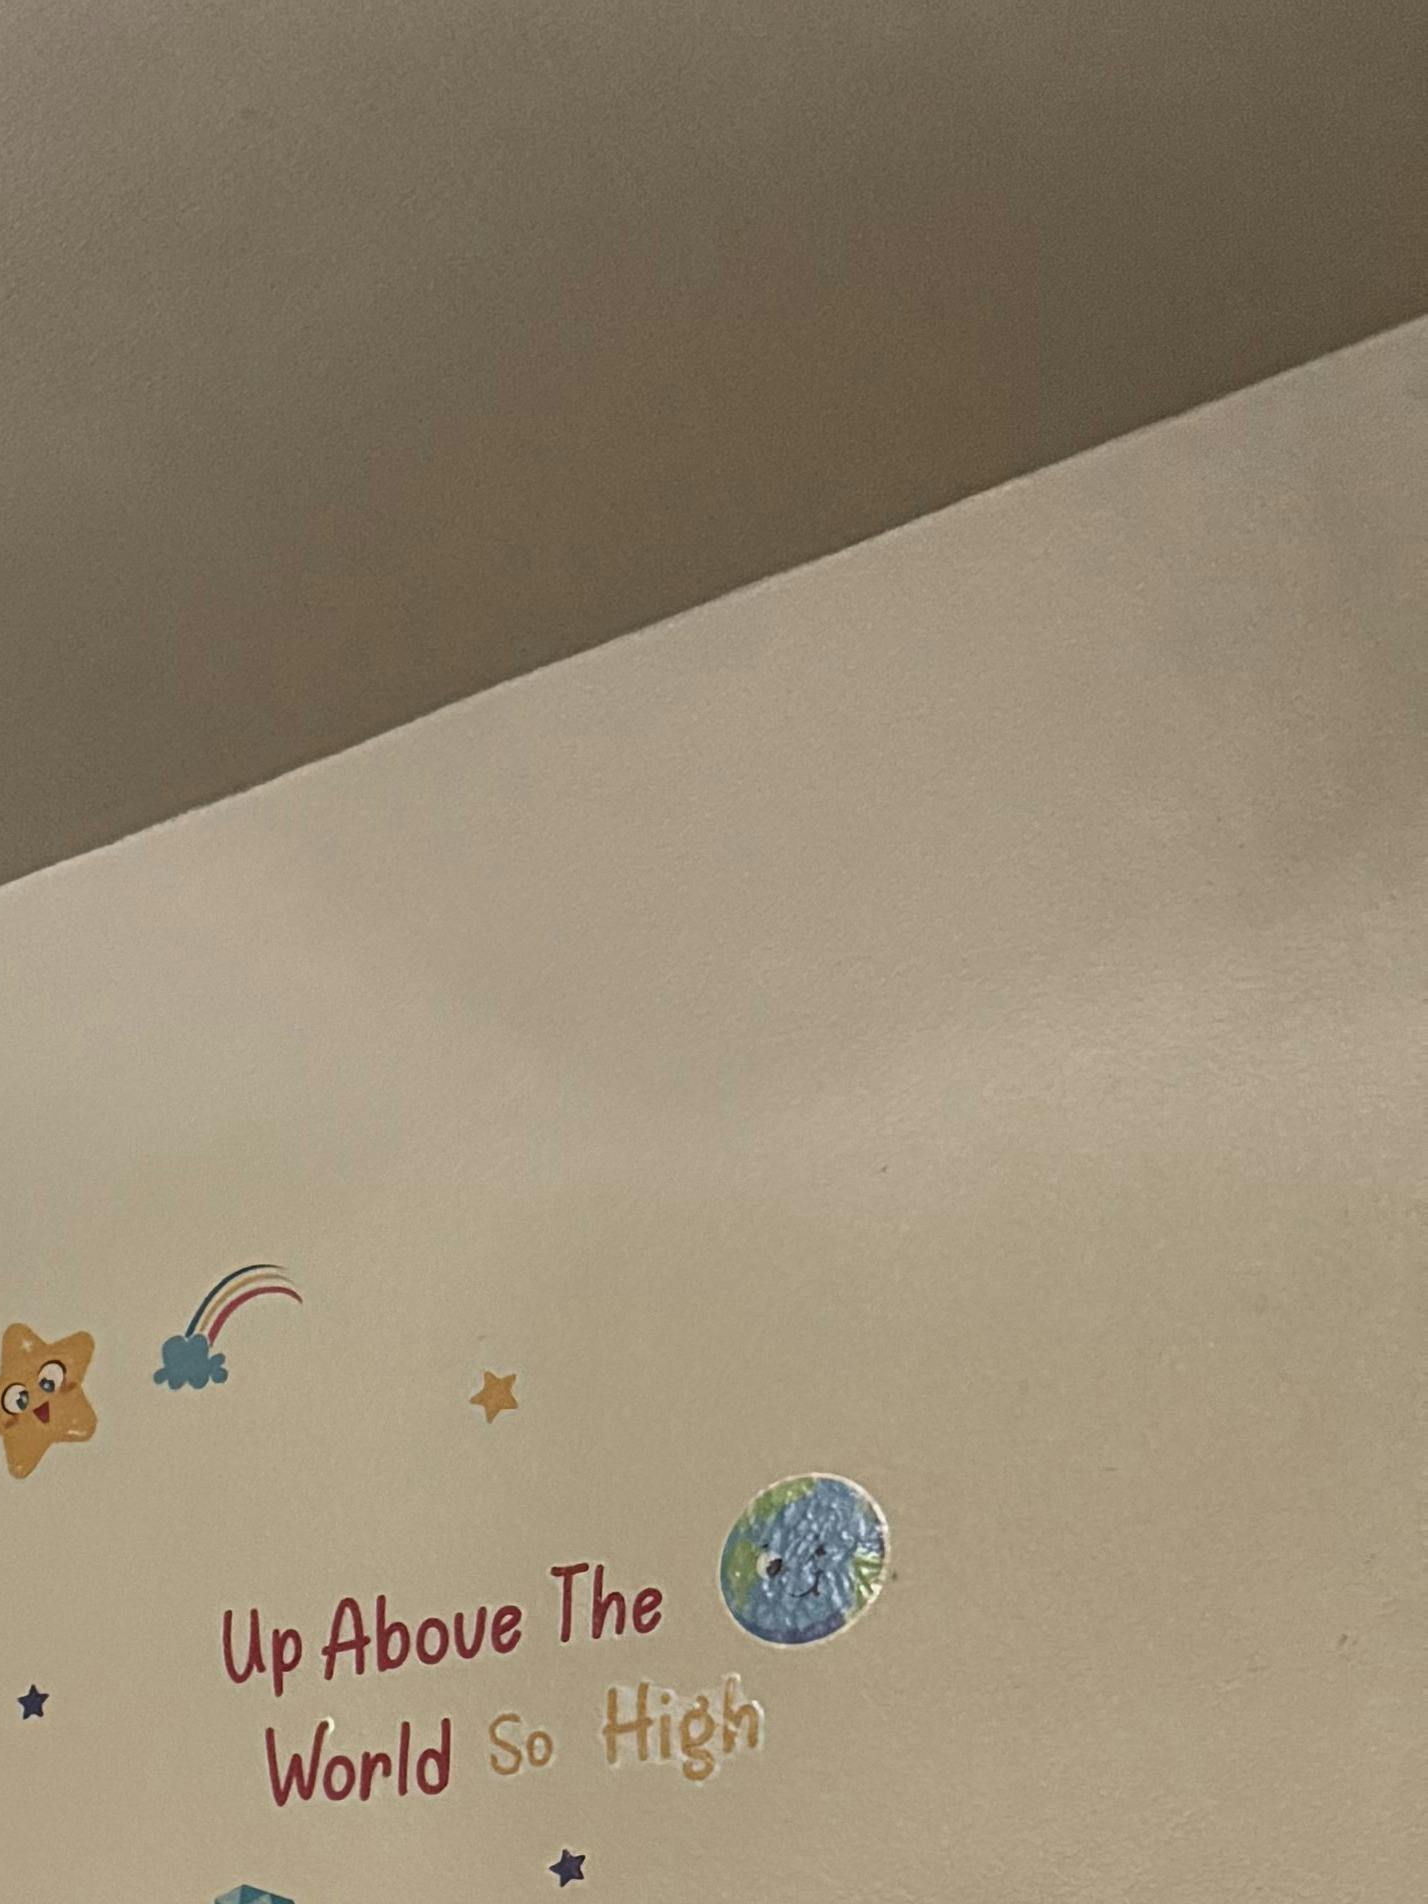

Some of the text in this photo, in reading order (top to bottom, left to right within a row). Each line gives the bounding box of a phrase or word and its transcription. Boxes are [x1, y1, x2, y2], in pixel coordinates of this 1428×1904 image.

[223, 1563, 662, 1697] Up Above The
[265, 1676, 762, 1807] World So High
